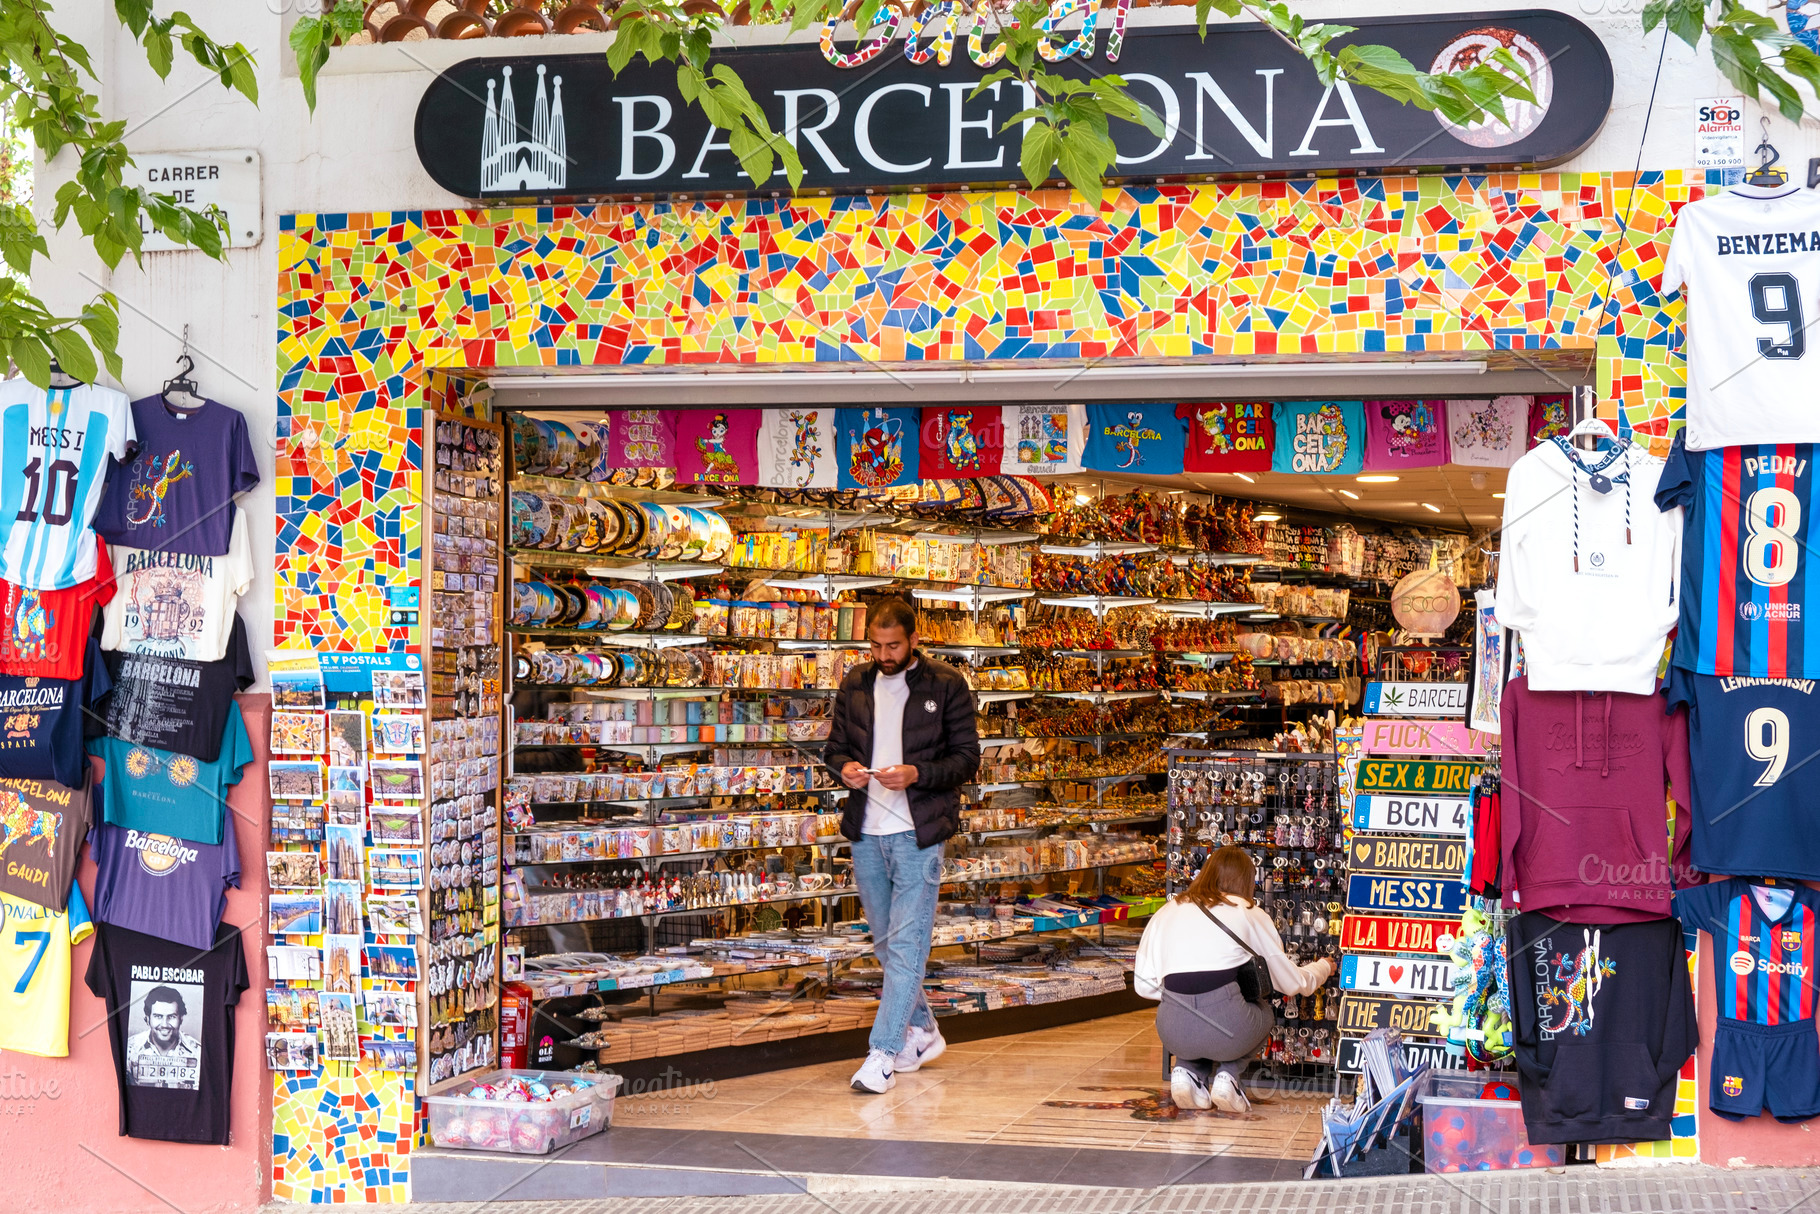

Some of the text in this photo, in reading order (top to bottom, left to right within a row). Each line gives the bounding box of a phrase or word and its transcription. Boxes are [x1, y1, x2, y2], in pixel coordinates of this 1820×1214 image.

[1699, 106, 1740, 125] Stop
[1698, 123, 1741, 133] Alarma
[148, 165, 219, 182] CARRER
[173, 189, 195, 204] DE
[1717, 231, 1820, 255] BENZEMA
[1748, 272, 1806, 360] 9
[1235, 403, 1264, 419] BAR
[1104, 427, 1162, 441] BARCELONA
[1236, 420, 1264, 435] CEL
[1296, 413, 1327, 435] BAR
[30, 426, 84, 451] MESSI
[1235, 436, 1266, 451] ONA
[1293, 434, 1329, 454] CEL
[850, 461, 905, 488] BARCELONA
[1292, 454, 1331, 473] ONA
[1744, 455, 1807, 478] PEDRI
[15, 457, 80, 526] 10
[1743, 487, 1801, 587] 8
[126, 550, 213, 579] BARCELONA
[4, 581, 15, 616] Gaud
[1764, 602, 1801, 611] UNHCR
[125, 615, 205, 632] 19 92
[1764, 610, 1801, 619] ACNUR
[343, 656, 391, 665] POSTALS
[121, 660, 200, 688] BARCELONA
[1369, 701, 1376, 709] E
[1, 739, 36, 749] SPAIN
[1373, 725, 1434, 750] FUCK
[1545, 722, 1646, 752] Baceona
[1744, 707, 1790, 787] 9
[1364, 763, 1483, 790] SEX & DRU
[0, 777, 71, 807] ARCELONA
[132, 790, 176, 804] BARCELONA
[1387, 800, 1439, 828] BCN
[1452, 803, 1466, 829] 4
[125, 829, 198, 865] Barcelona
[1374, 841, 1466, 871] BARCELON
[149, 856, 167, 866] CITY
[1369, 879, 1444, 910] MESSI
[1354, 920, 1377, 947] LA
[1388, 921, 1433, 949] VIDA
[1740, 935, 1761, 944] BARÇA
[14, 931, 51, 994] 7
[1345, 976, 1352, 984] E
[1369, 961, 1381, 987] I
[1757, 958, 1809, 979] Spotify
[131, 965, 205, 984] PABLO ESCOBAR
[1534, 937, 1555, 1041] BARCELONA
[1347, 1001, 1440, 1031] THE GODF
